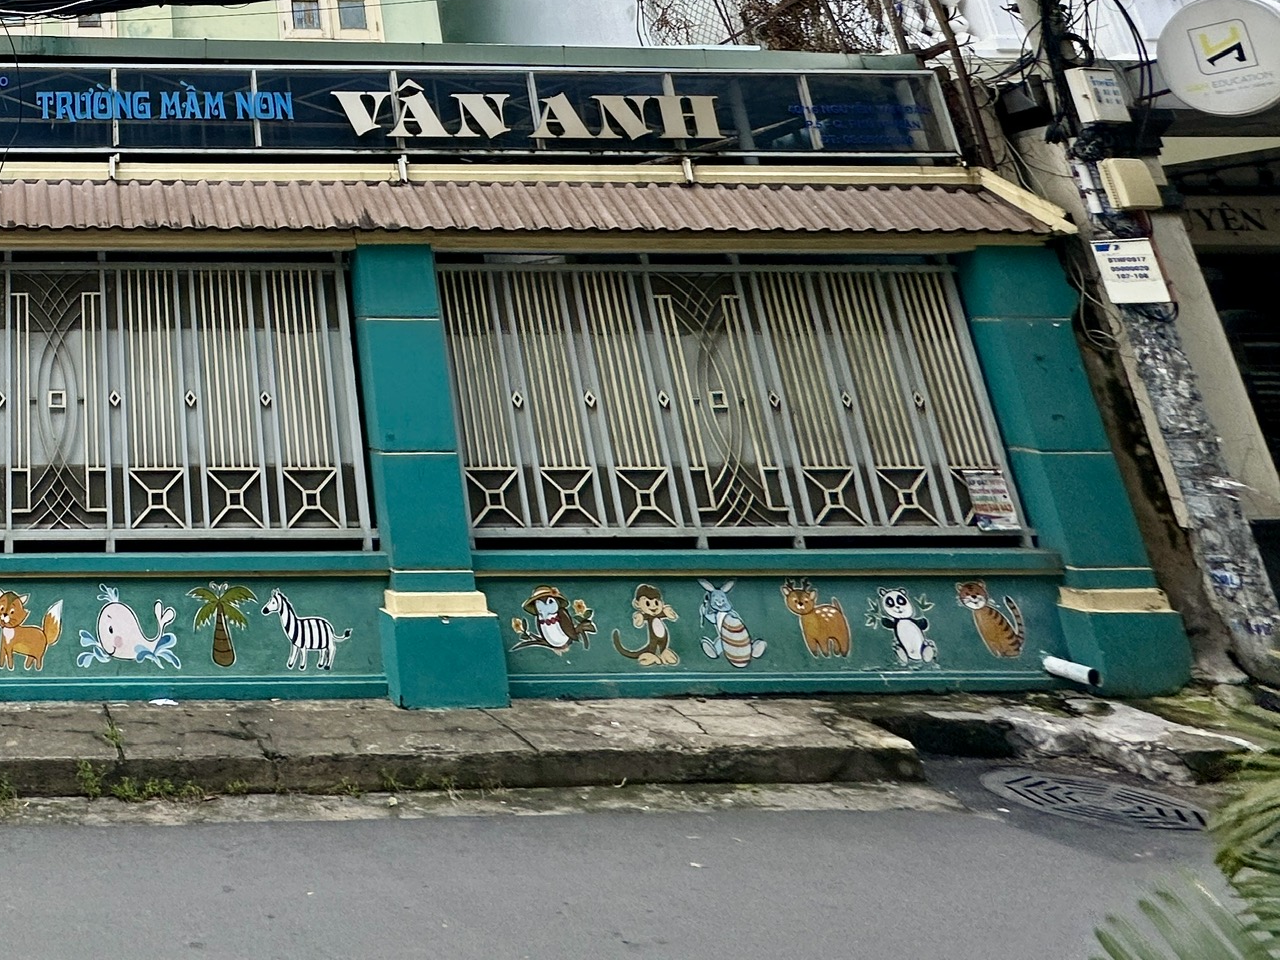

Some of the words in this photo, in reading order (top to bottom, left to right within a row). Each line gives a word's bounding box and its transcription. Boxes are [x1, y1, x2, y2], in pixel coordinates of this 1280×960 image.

[36, 83, 151, 122] TRƯỜNG
[160, 80, 226, 119] MẦM
[235, 91, 294, 120] NON
[330, 78, 511, 139] VÂN
[528, 91, 727, 140] ANH
